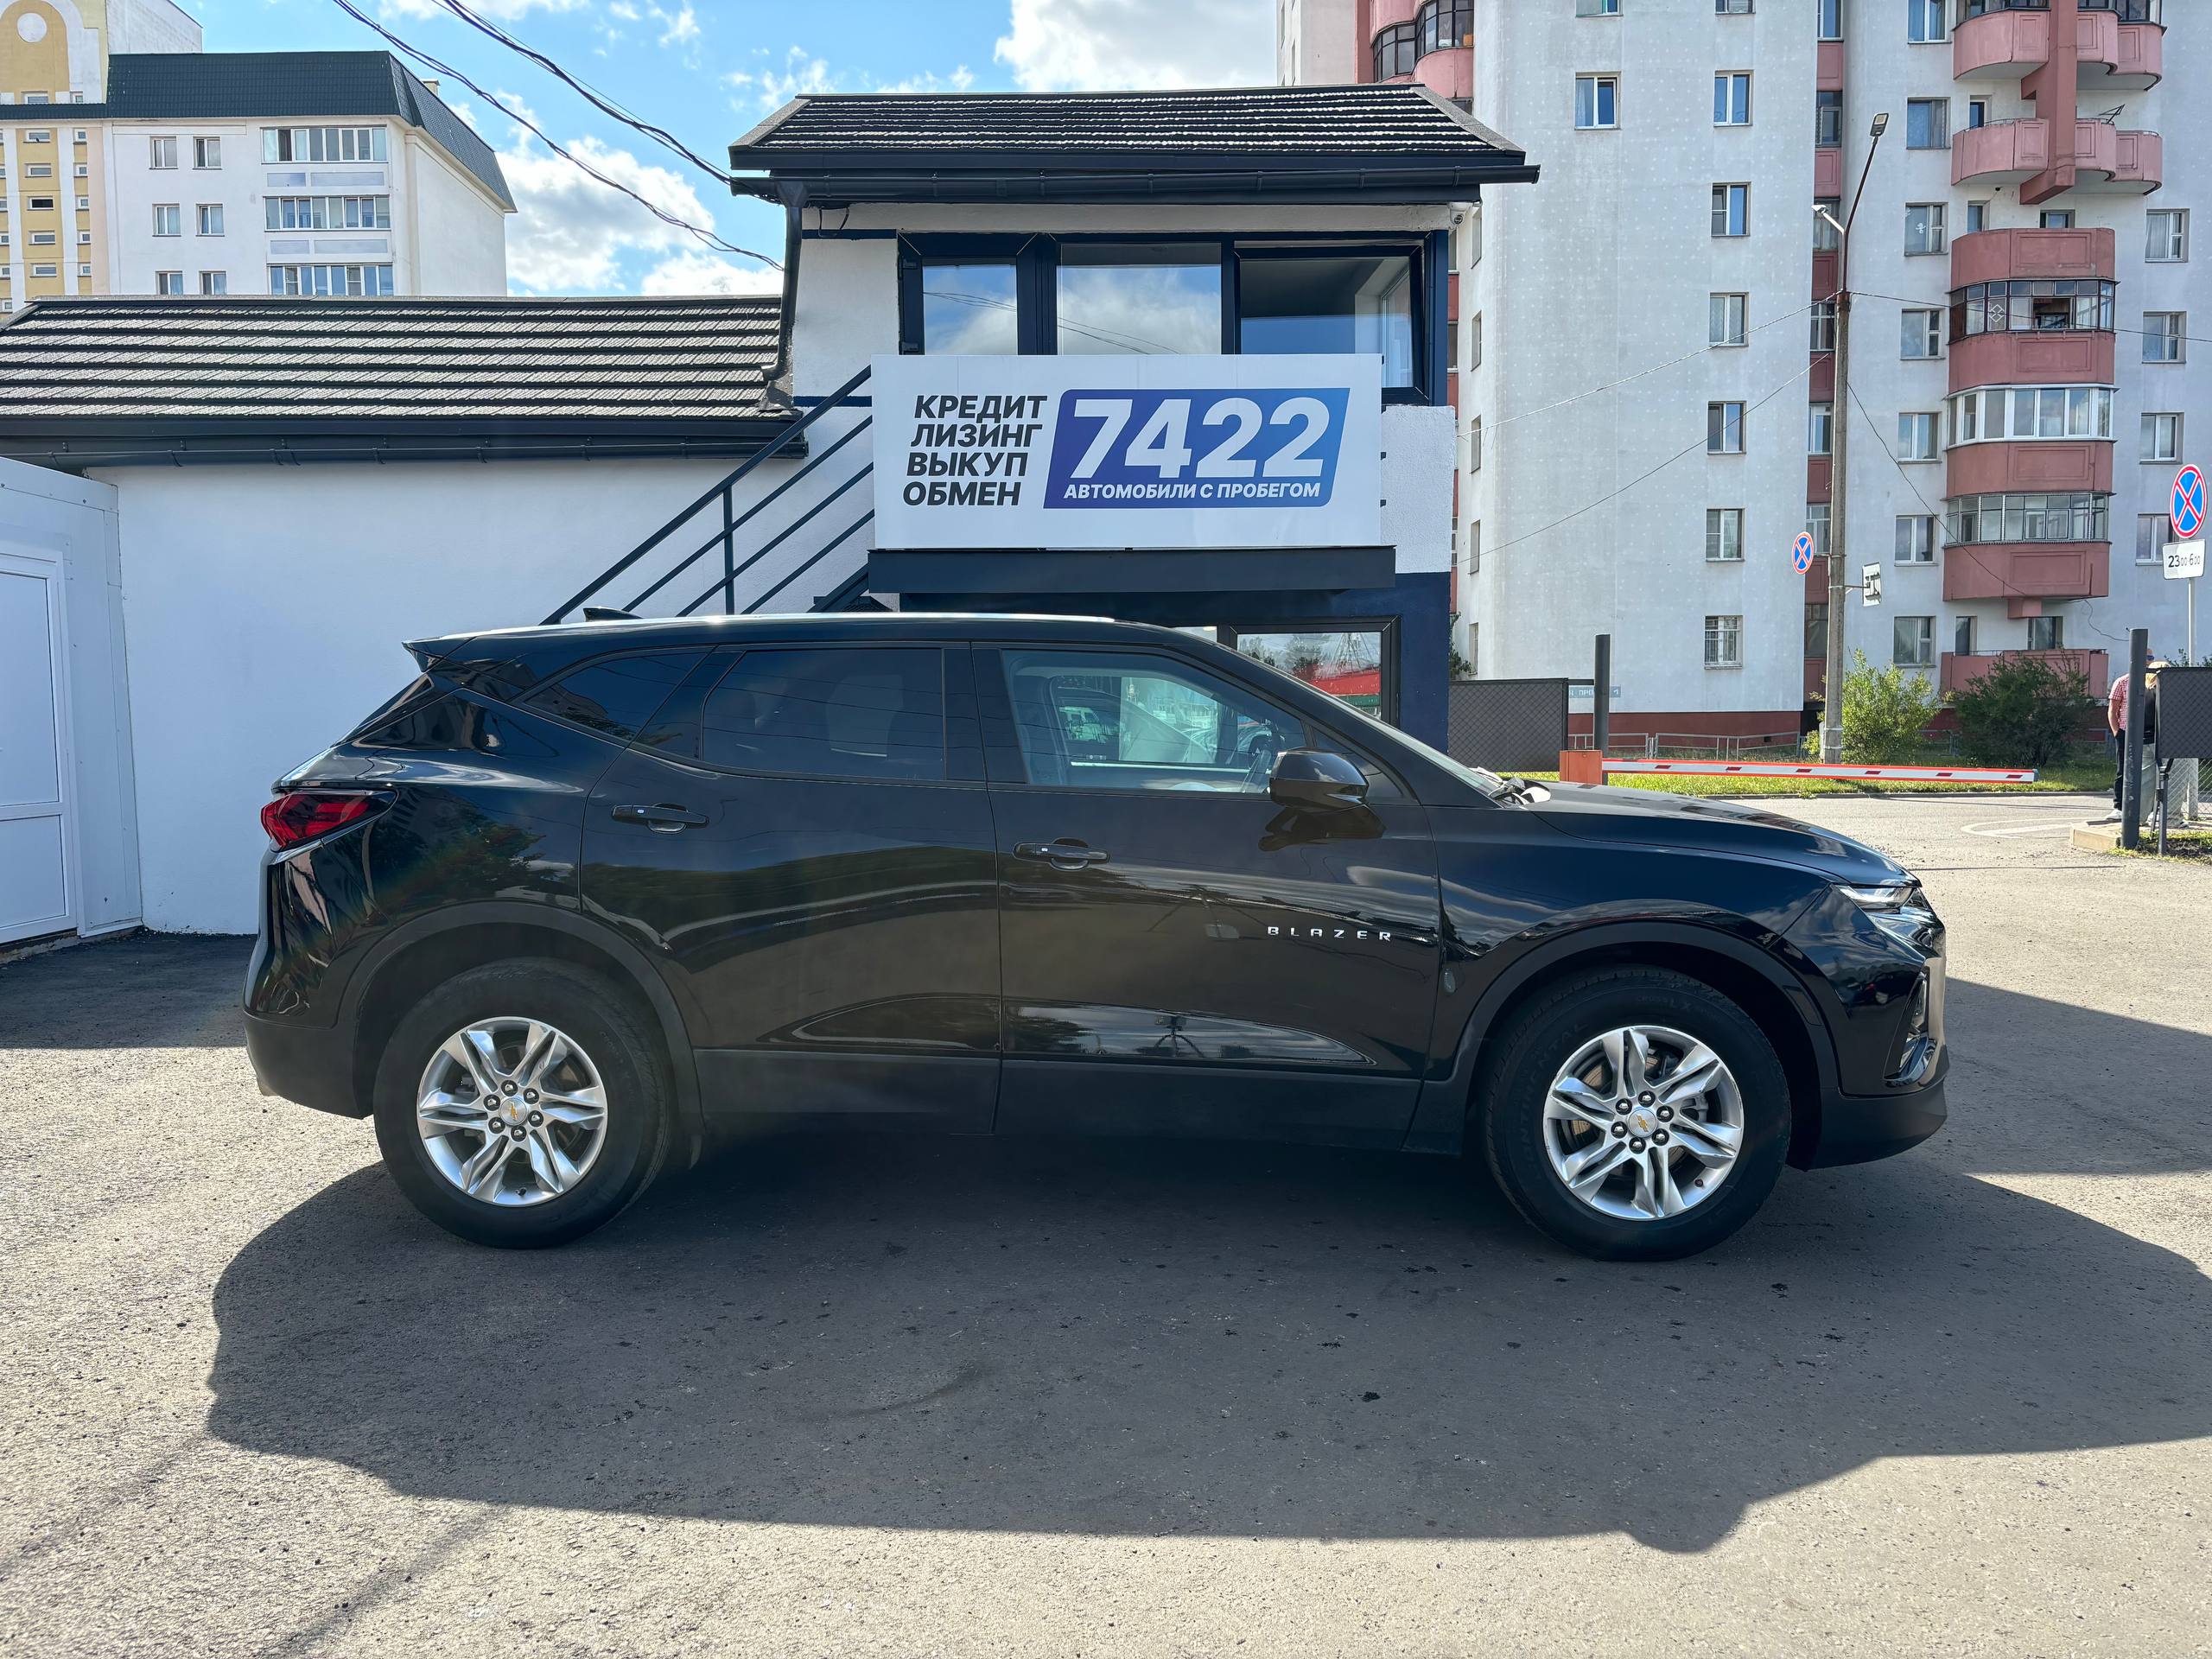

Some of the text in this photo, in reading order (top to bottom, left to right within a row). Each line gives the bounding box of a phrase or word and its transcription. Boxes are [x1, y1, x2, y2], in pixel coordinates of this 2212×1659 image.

[914, 395, 1048, 424] КРЕДИТ
[910, 423, 1043, 448] ЛИЗИНГ
[1070, 397, 1331, 479] 7422
[906, 452, 1028, 477] ВЫКУП
[903, 480, 1021, 506] ОБМЕН
[1063, 482, 1321, 499] АВТОМОБИЛИ С ПРОБЕГОМ
[1267, 925, 1392, 942] BLAZER
